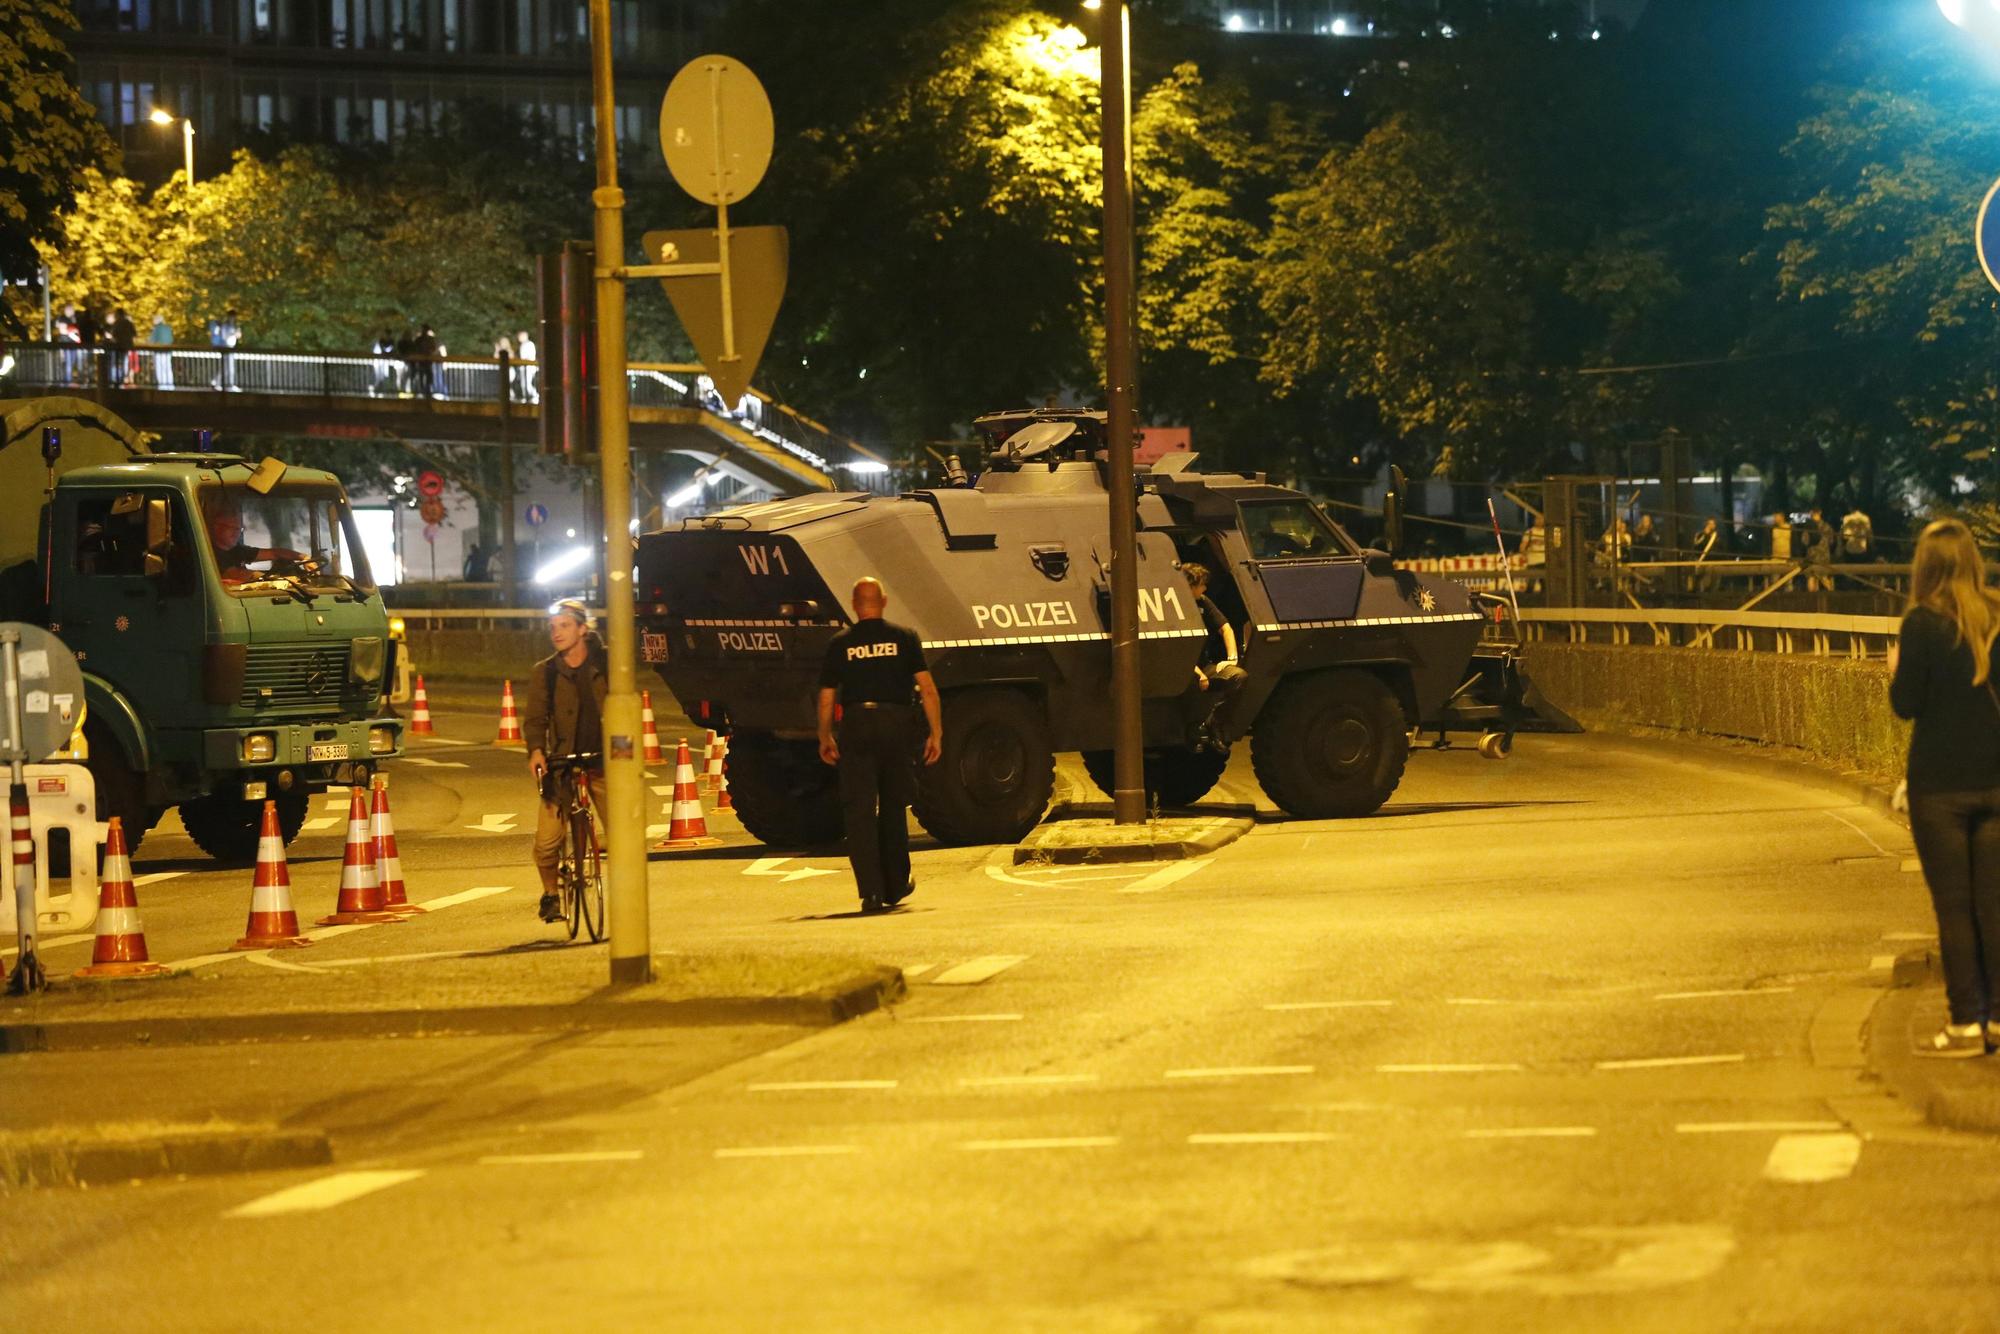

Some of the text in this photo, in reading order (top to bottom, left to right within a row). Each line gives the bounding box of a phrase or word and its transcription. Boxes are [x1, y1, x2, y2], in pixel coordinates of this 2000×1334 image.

[972, 601, 1077, 629] POLIZEI
[718, 632, 783, 650] POLIZEI
[847, 643, 897, 661] POLIZEI
